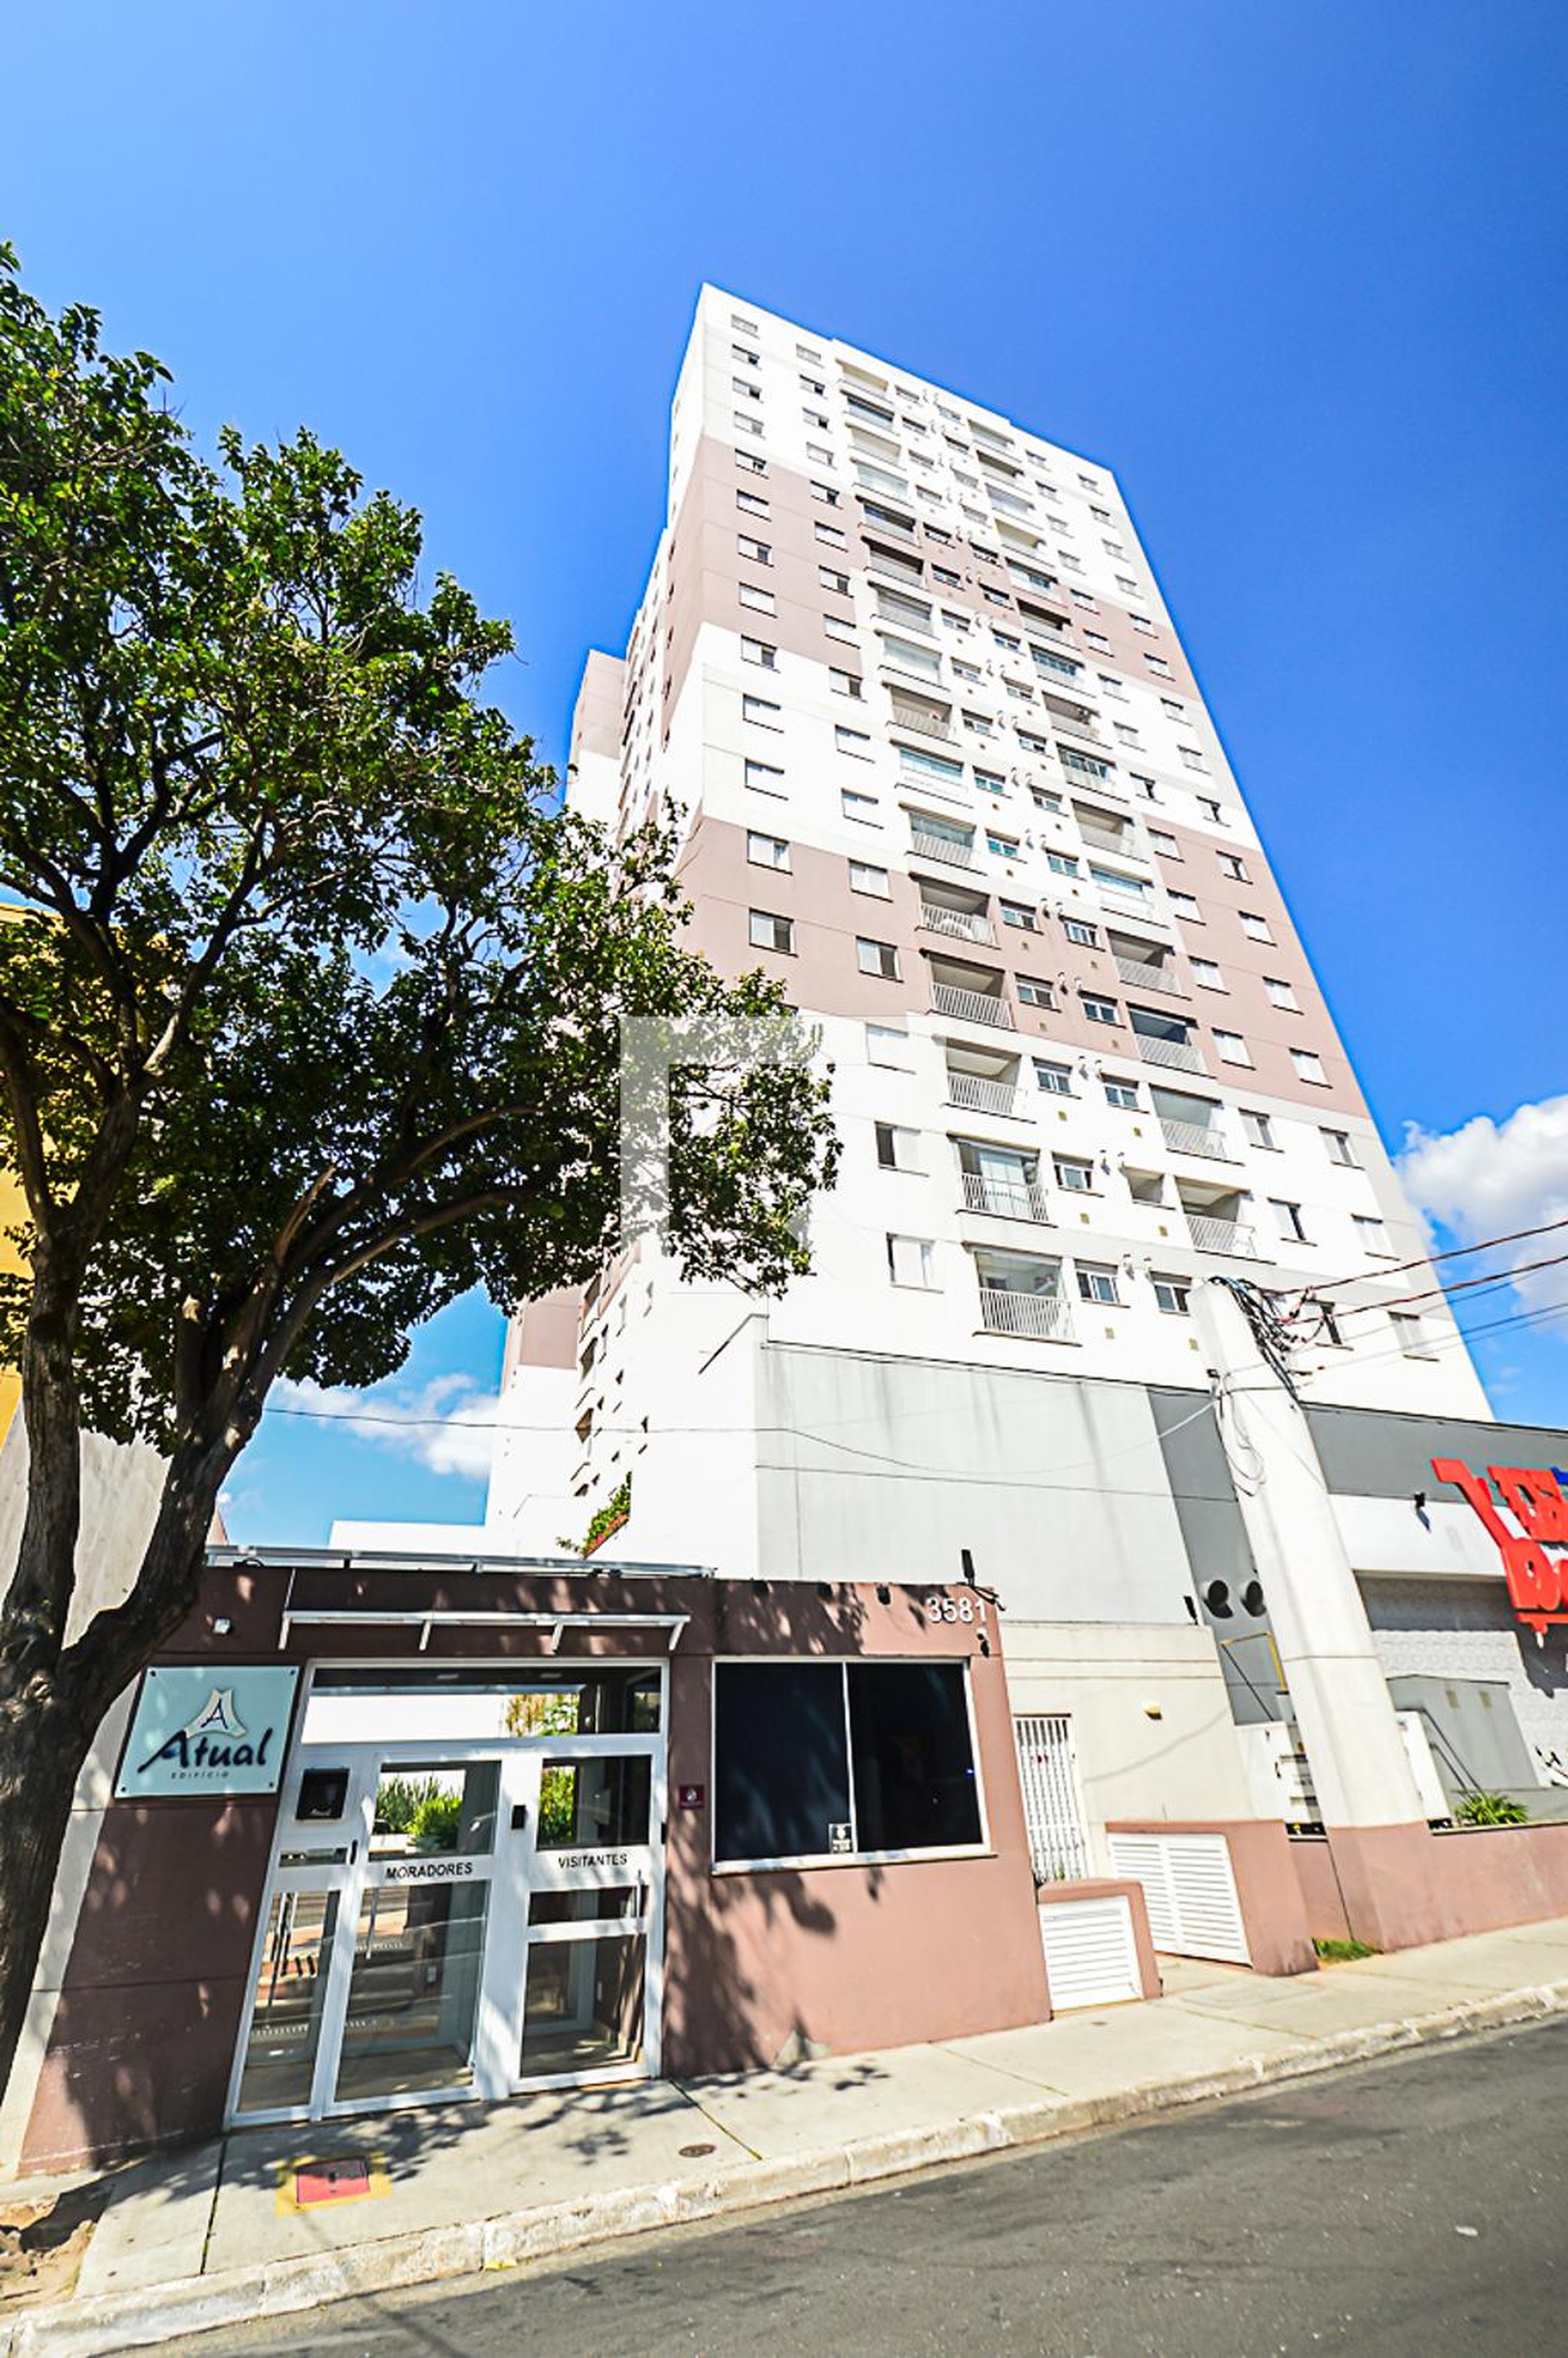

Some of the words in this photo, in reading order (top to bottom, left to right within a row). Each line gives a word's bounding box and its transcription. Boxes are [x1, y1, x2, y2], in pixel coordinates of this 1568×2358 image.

[926, 1597, 987, 1623] 3581
[137, 1727, 273, 1773] Atual
[386, 1861, 473, 1879] MORADORES
[558, 1853, 627, 1869] VISITANTES
